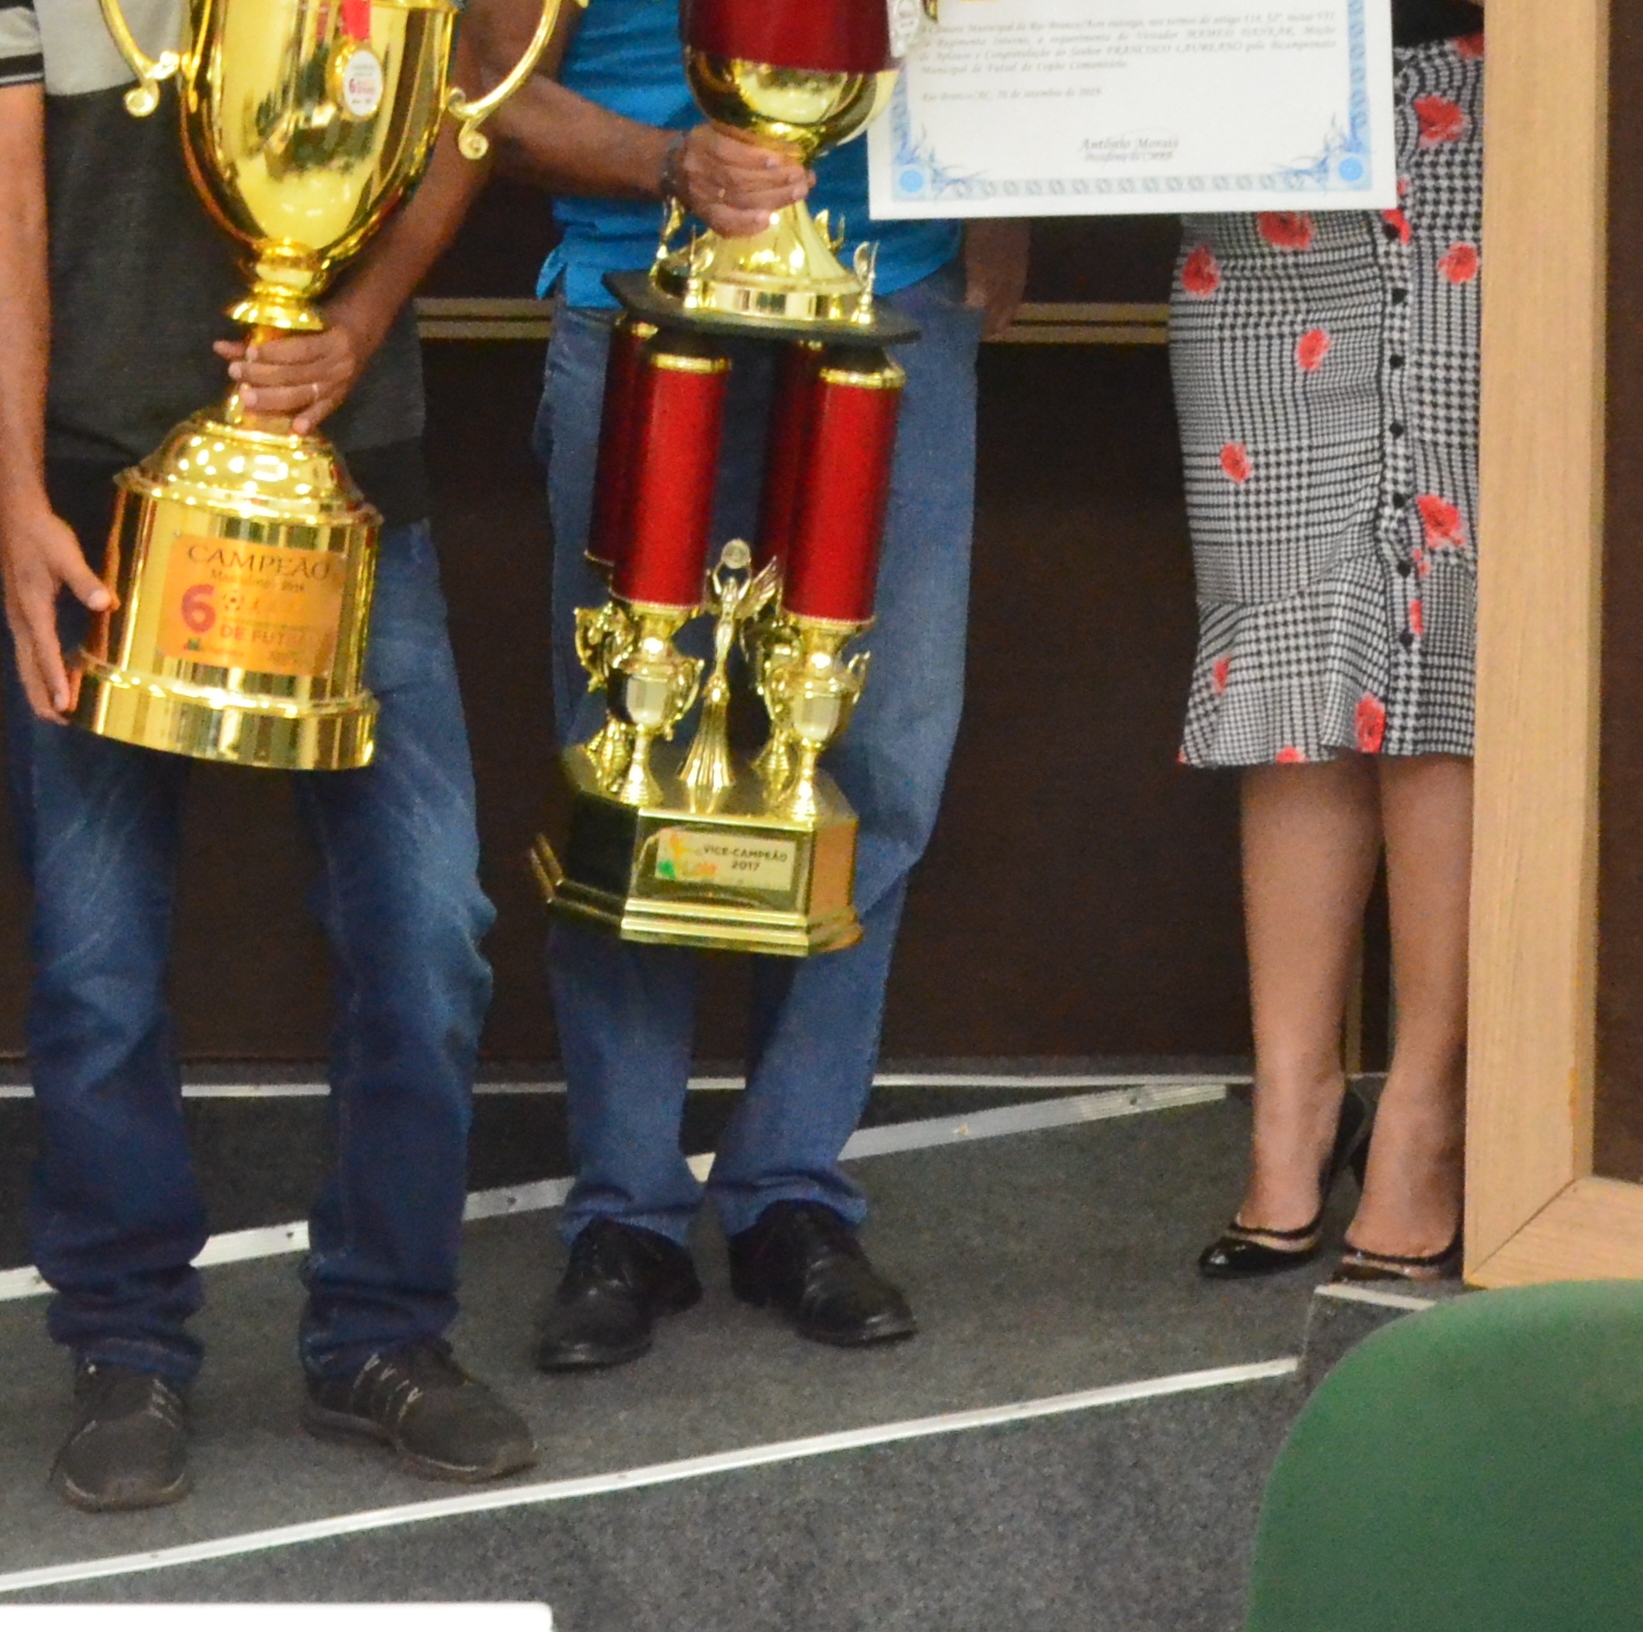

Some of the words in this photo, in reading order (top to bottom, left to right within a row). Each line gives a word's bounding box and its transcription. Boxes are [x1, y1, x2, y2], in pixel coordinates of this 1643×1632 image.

[187, 543, 331, 581] CAMPEÃO
[181, 583, 217, 635] 6
[219, 623, 245, 641] DE
[703, 844, 789, 863] VICE-CAMPEÃO
[731, 859, 761, 871] 2017
